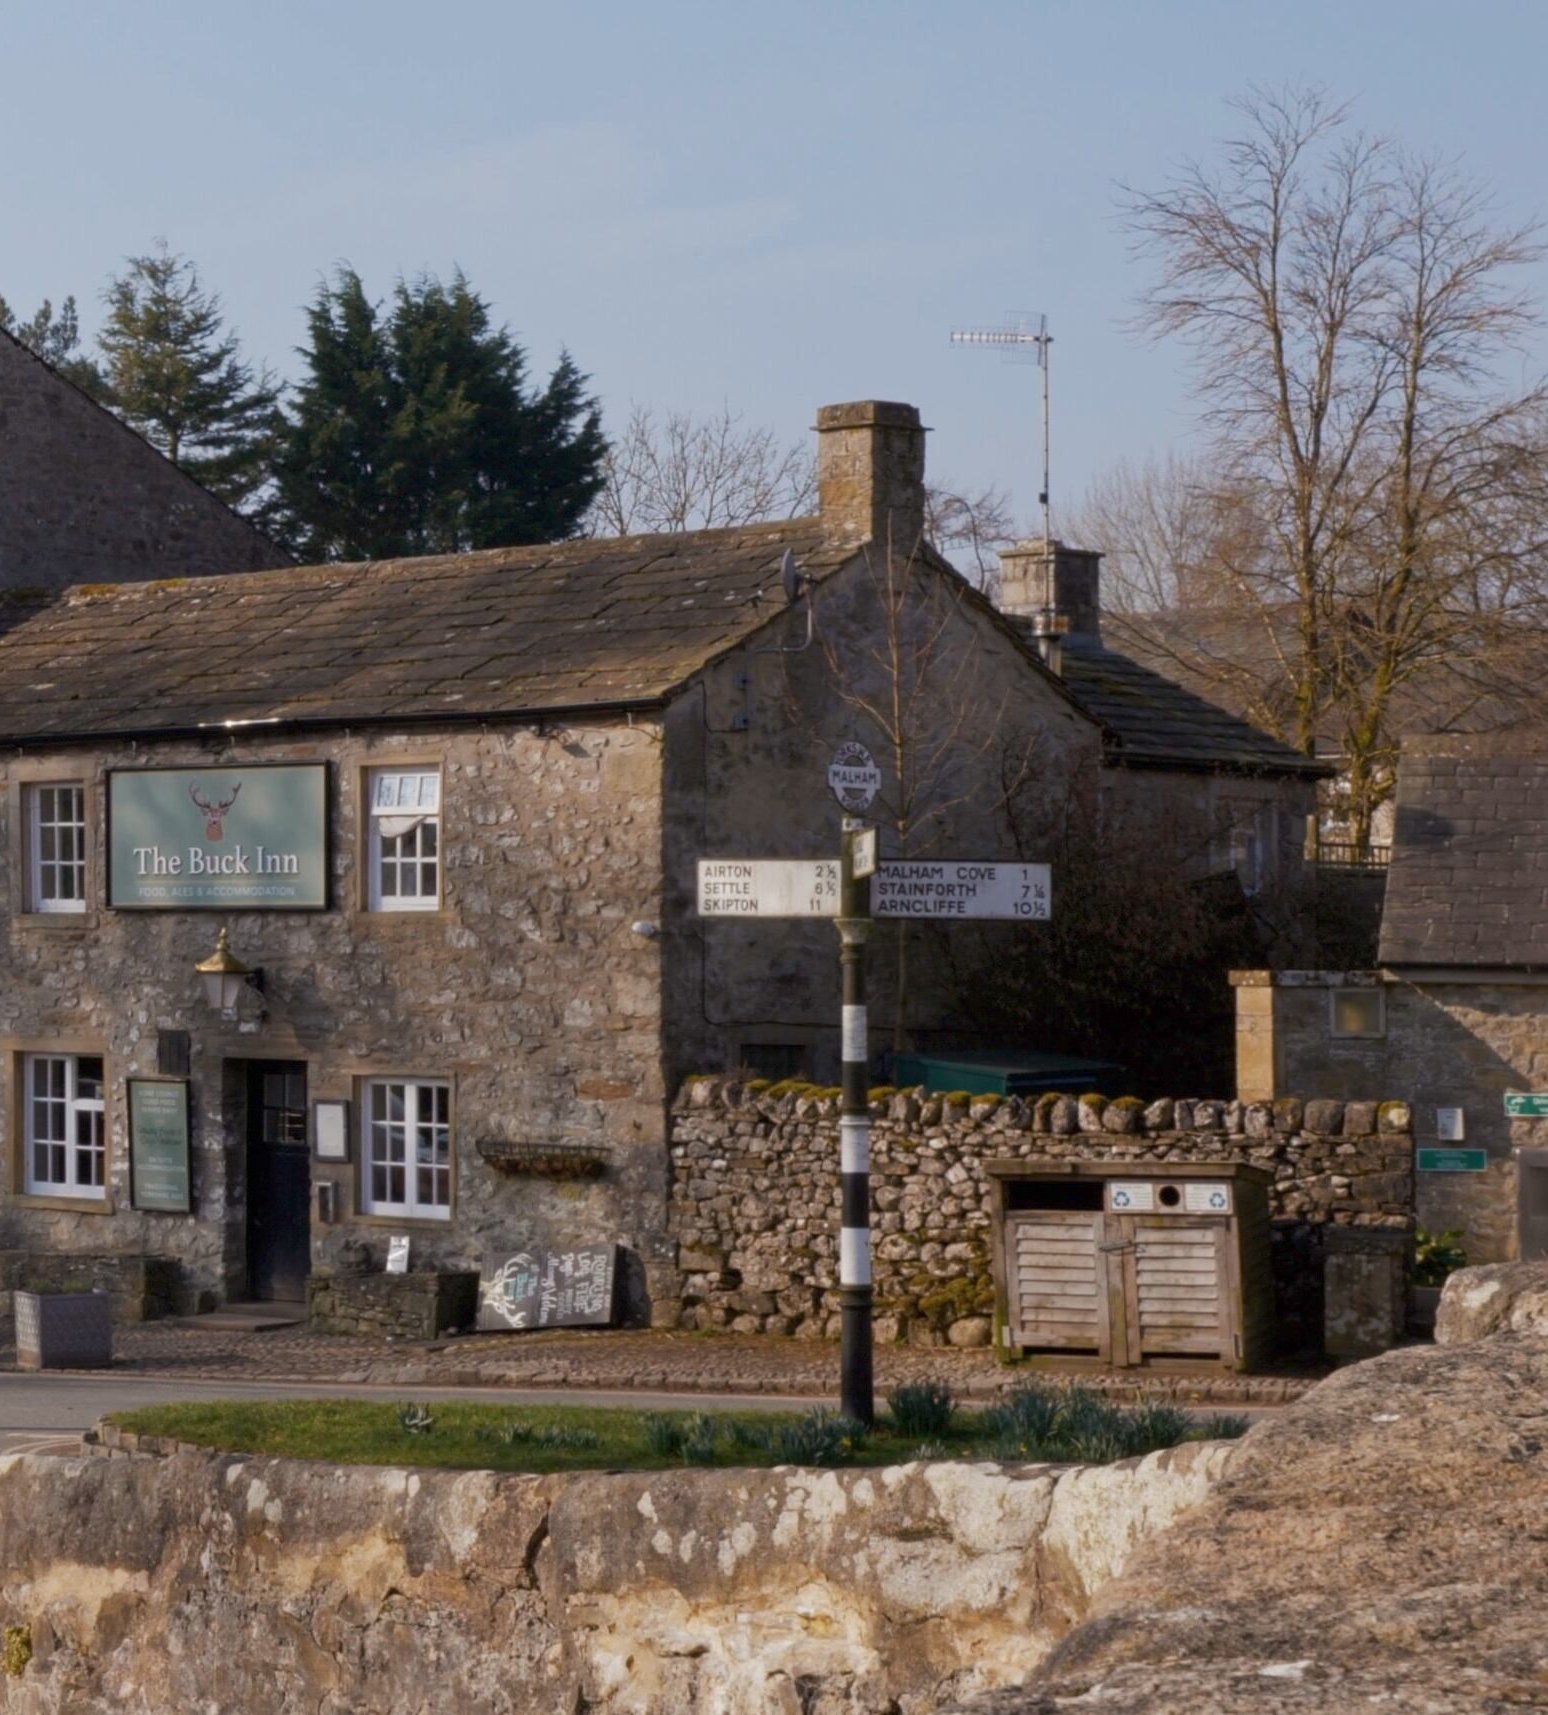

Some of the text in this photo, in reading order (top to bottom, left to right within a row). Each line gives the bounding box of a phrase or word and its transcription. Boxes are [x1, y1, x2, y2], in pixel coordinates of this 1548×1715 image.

[832, 771, 877, 784] MALHAM
[133, 845, 299, 875] The Buck Inn
[704, 865, 752, 878] AIRTON
[878, 866, 1028, 880] MALHAM COVE 1
[171, 886, 194, 897] ALES
[206, 886, 296, 897] ACCOMMODATION
[704, 882, 750, 895] SETTLE
[878, 882, 977, 897] STAINFORTH
[703, 899, 821, 911] SKIPTON 11
[878, 900, 966, 914] ARNCLIFFE
